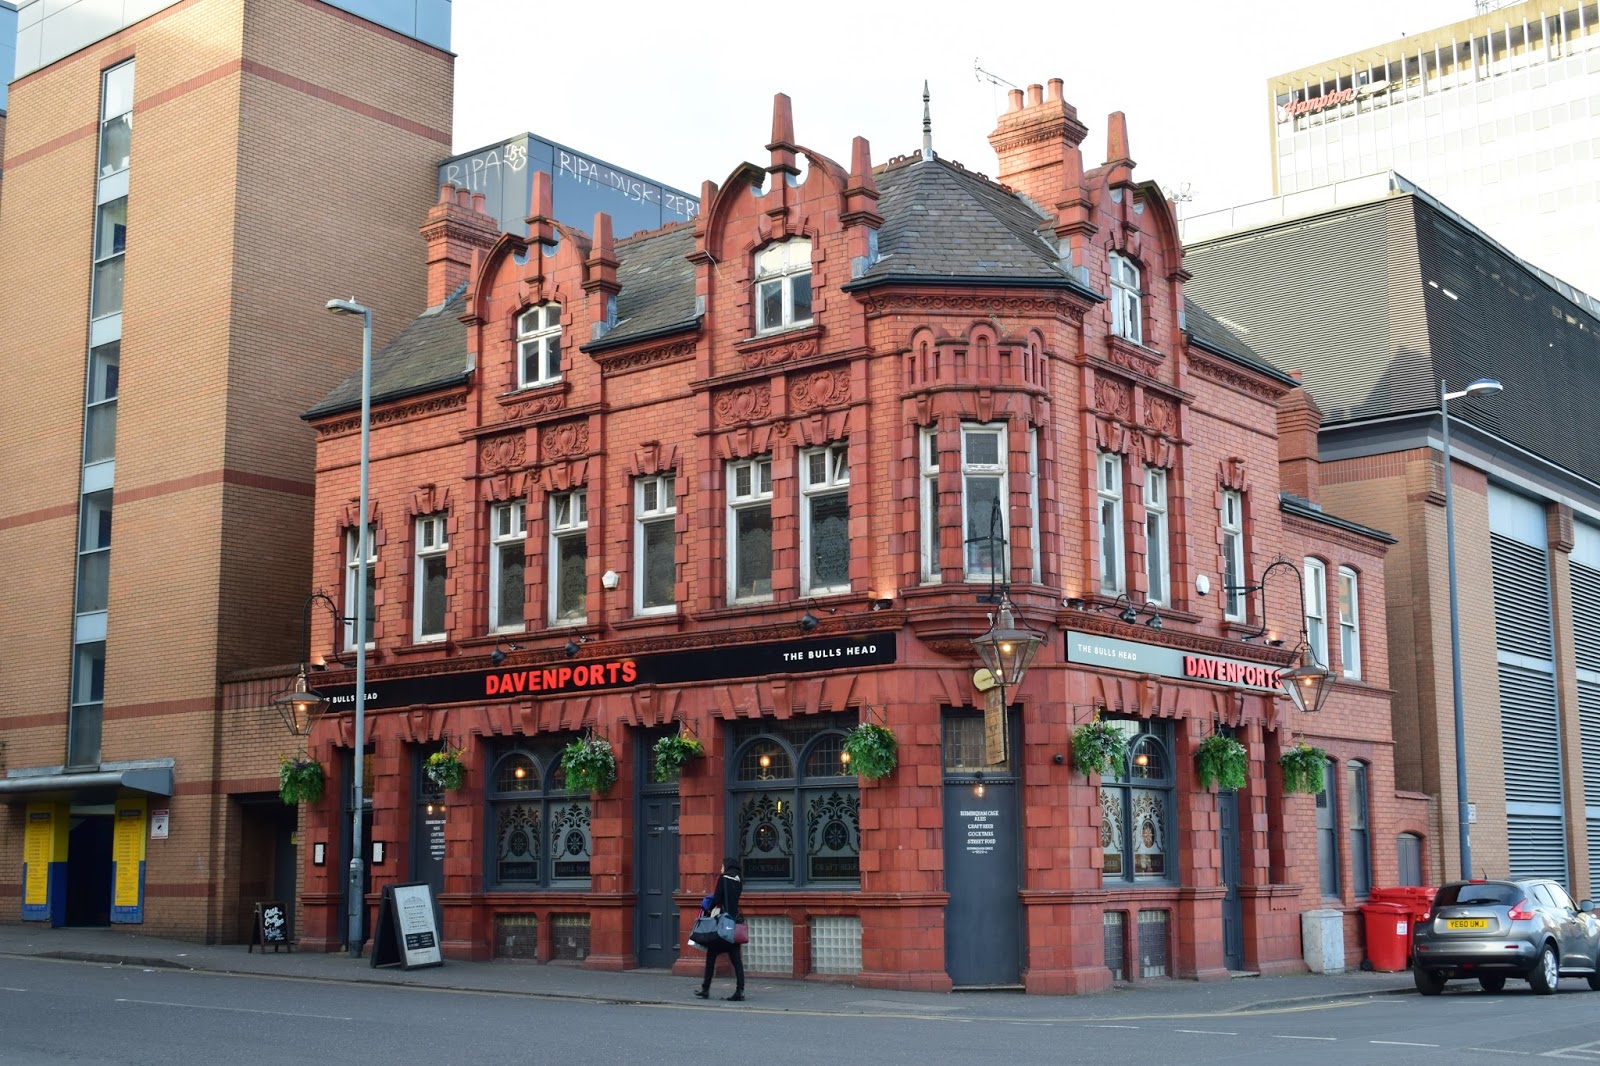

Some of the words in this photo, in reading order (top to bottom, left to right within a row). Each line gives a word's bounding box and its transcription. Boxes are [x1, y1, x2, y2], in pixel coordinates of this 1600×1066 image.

[1277, 87, 1358, 123] Hampton
[447, 151, 502, 190] RIPA
[560, 151, 598, 185] RIPA
[783, 652, 804, 661] THE
[808, 648, 842, 659] BULLS
[846, 645, 877, 656] HEAD
[1077, 643, 1092, 654] THE
[1094, 646, 1116, 658] BULLS
[1118, 649, 1137, 661] HEAD
[485, 660, 637, 695] DAVENPORTS
[1183, 655, 1285, 690] DAVENPORTS
[332, 694, 355, 704] BULLS
